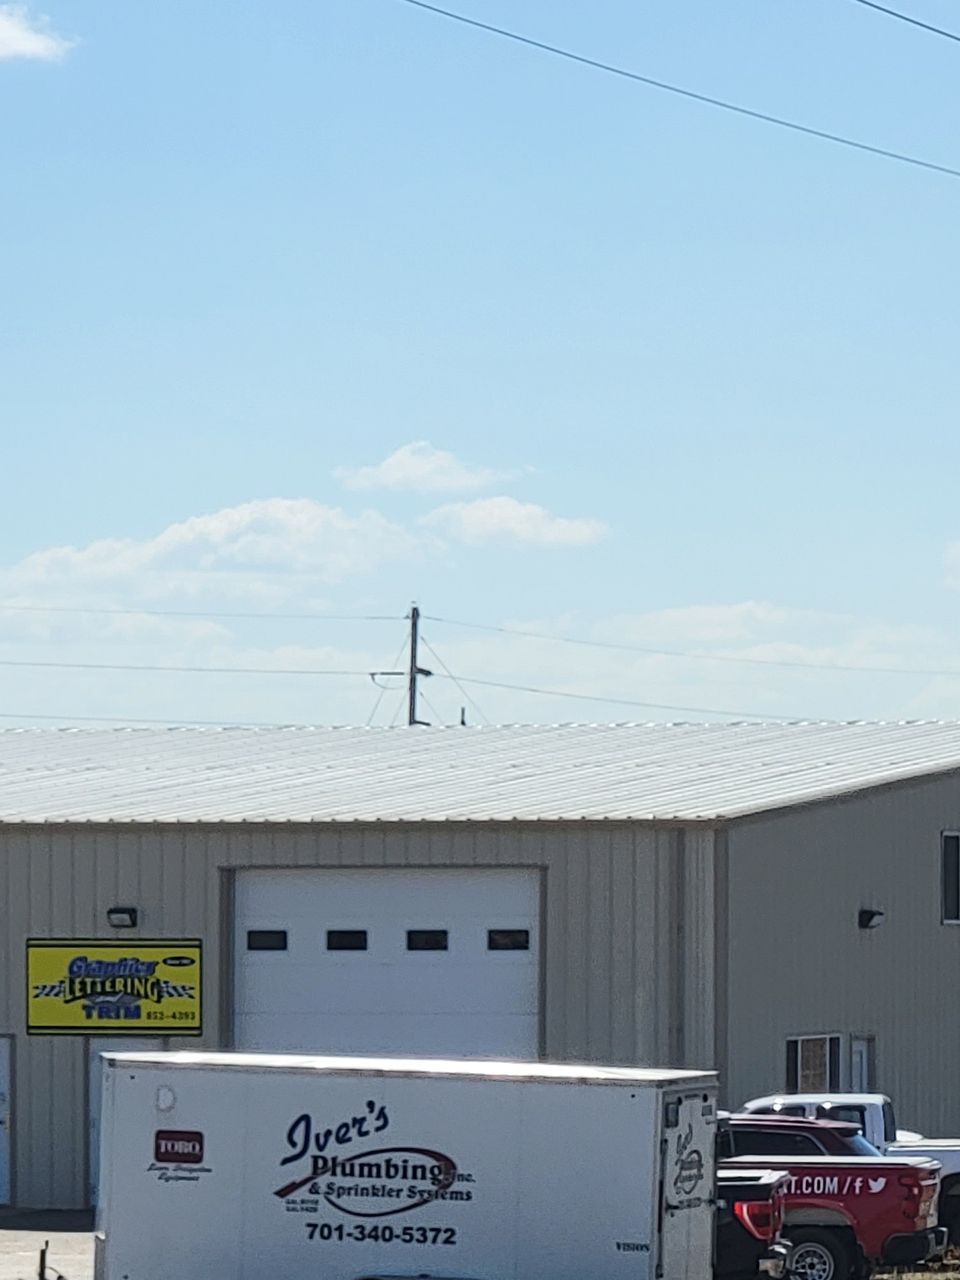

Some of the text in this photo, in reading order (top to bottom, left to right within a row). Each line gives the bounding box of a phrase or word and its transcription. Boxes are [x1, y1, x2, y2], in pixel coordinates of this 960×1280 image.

[64, 976, 161, 1004] LETTERING
[82, 1003, 142, 1020] TRIM
[280, 1100, 389, 1166] Iver's
[158, 1140, 200, 1154] TORO
[311, 1154, 442, 1187] Plumbing
[308, 1181, 473, 1203] & Sprinkler Systems
[305, 1222, 458, 1245] 701-340-5372
